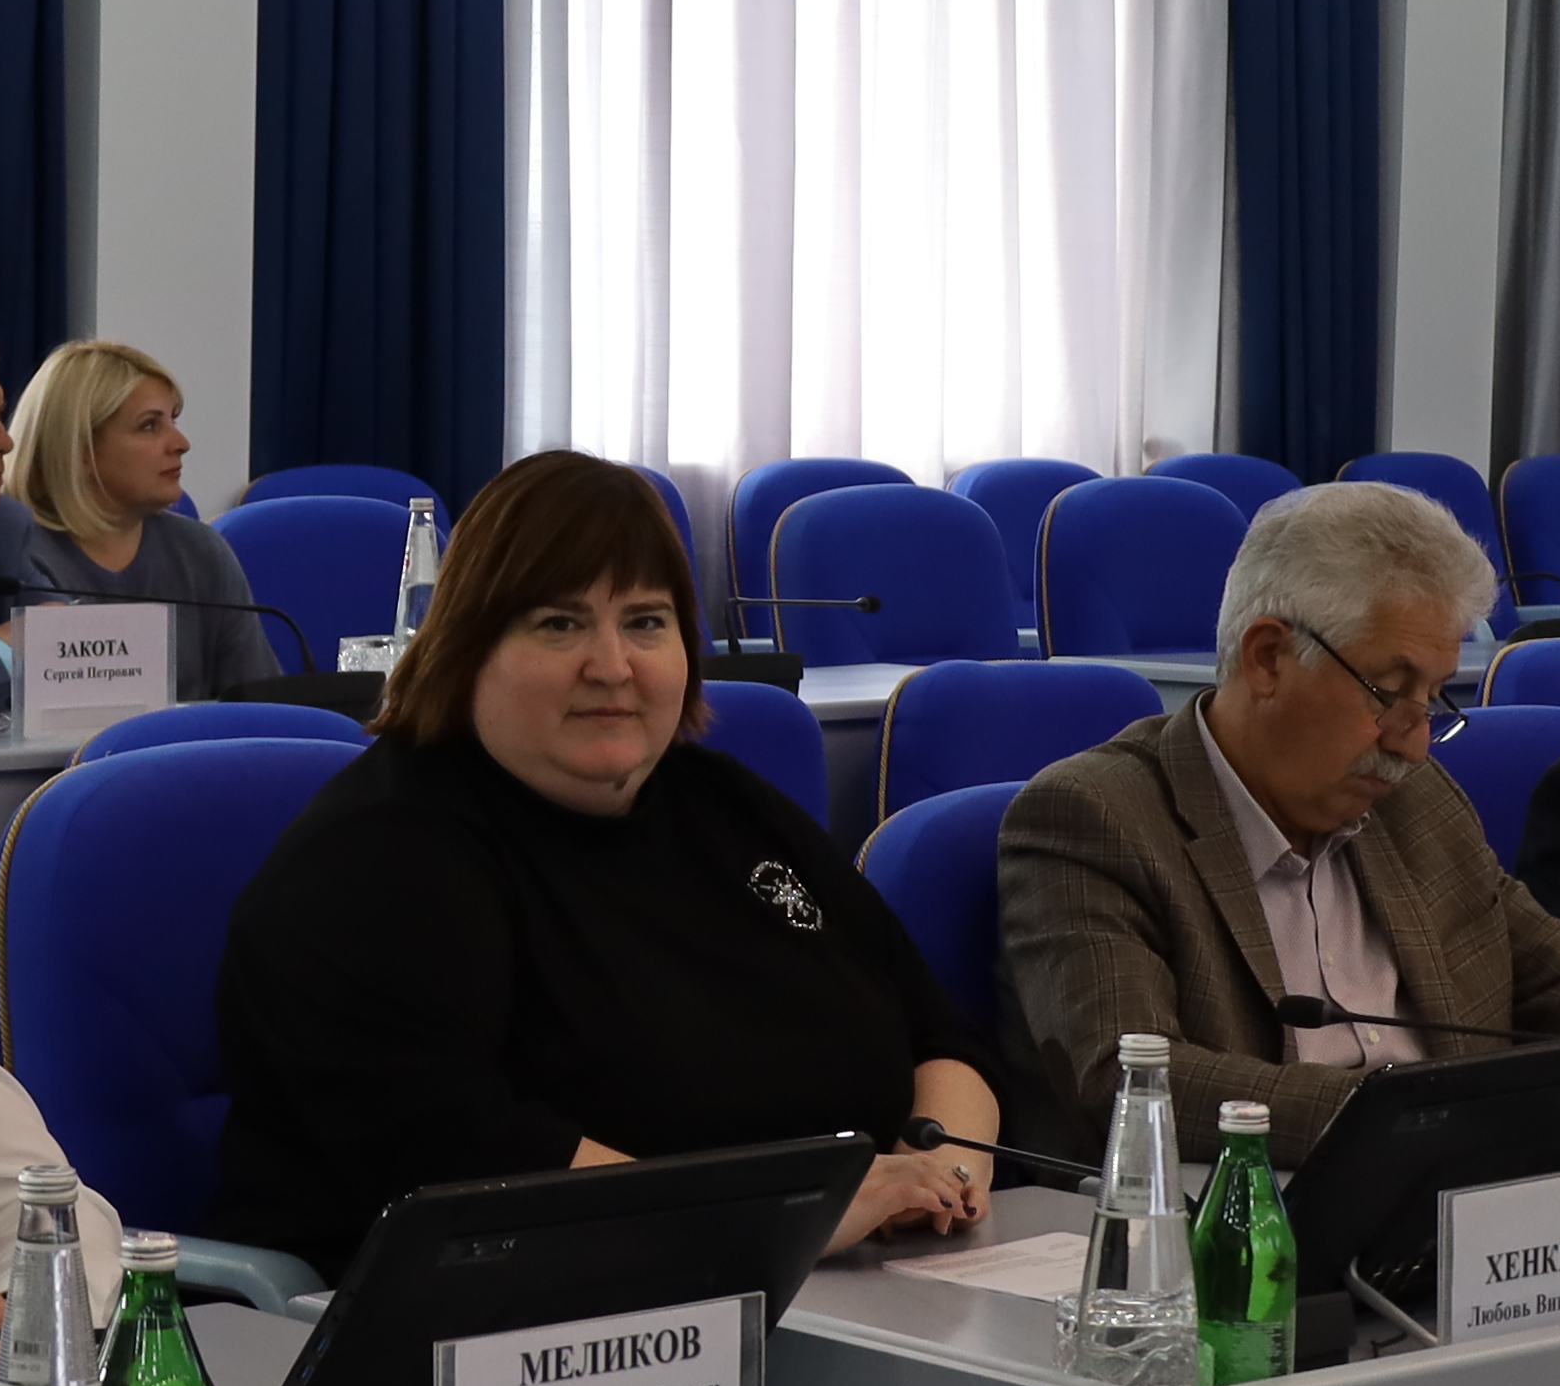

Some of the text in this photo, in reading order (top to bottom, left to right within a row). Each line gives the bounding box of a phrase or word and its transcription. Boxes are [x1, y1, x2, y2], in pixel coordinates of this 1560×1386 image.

[56, 639, 130, 659] ЗАКОТА
[43, 666, 143, 684] Сергей Петрович
[1467, 1300, 1532, 1329] Любовь
